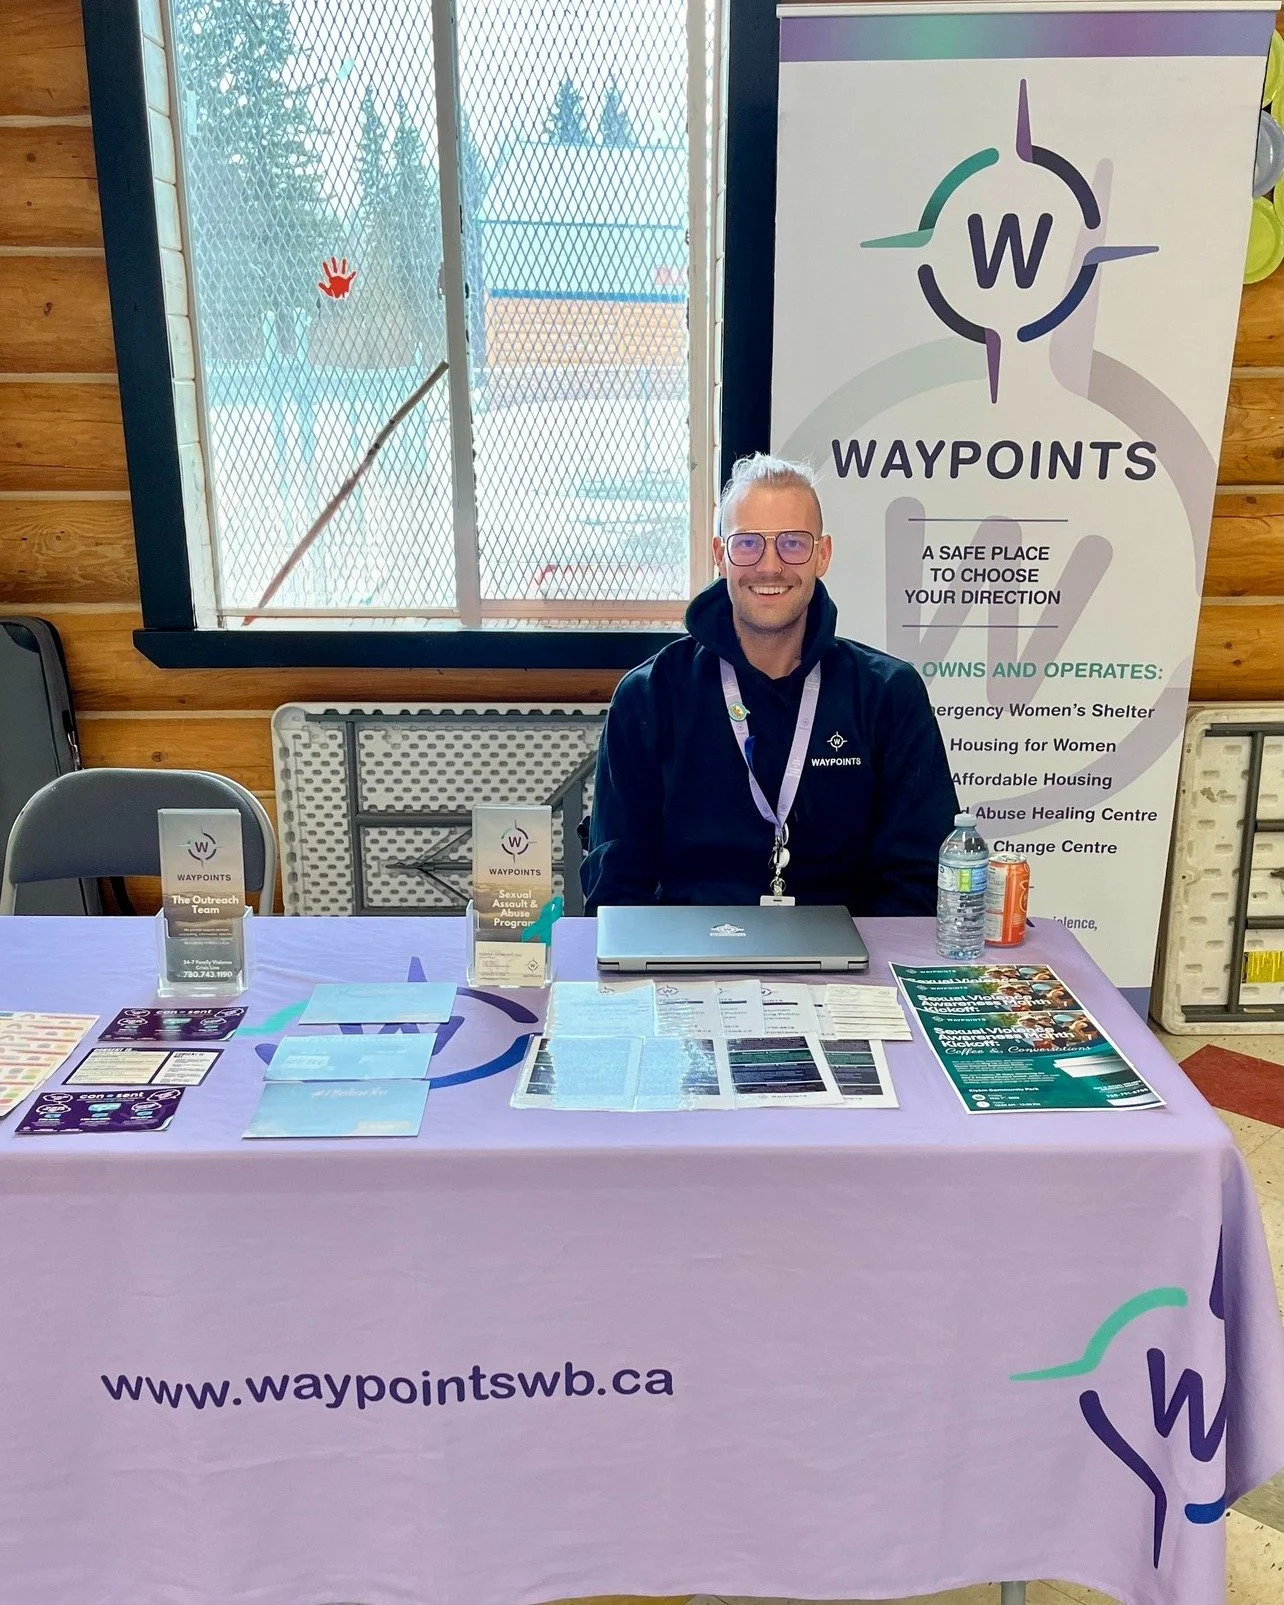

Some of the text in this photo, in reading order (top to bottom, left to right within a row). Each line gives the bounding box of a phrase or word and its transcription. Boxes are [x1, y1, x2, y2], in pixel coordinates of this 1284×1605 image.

[967, 212, 1054, 290] W
[831, 439, 1157, 481] WAYPOINTS
[921, 545, 1050, 561] A SAFE PLACE
[930, 568, 1039, 583] TO CHOOSE
[905, 589, 1061, 605] YOUR DIRECTION
[922, 661, 986, 678] OWNS
[992, 662, 1037, 678] AND
[1044, 662, 1163, 680] OPERATES:
[931, 705, 1004, 720] ergency
[1092, 704, 1156, 718] Shelter
[950, 738, 1116, 755] Housing for Women
[811, 757, 861, 767] WAYPOINTS
[951, 772, 1112, 790] Affordable Housing
[975, 806, 1026, 820] Abuse
[1032, 807, 1095, 822] Healing
[1101, 808, 1158, 822] Centre
[194, 842, 209, 853] W
[508, 836, 522, 848] W
[993, 840, 1118, 855] Change Centre
[172, 895, 240, 904] The Outreach
[498, 890, 532, 899] Sexual
[192, 905, 220, 914] Team
[492, 900, 538, 908] Assault &
[500, 908, 530, 918] Abuse
[100, 1362, 674, 1410] www.waypointswb.ca
